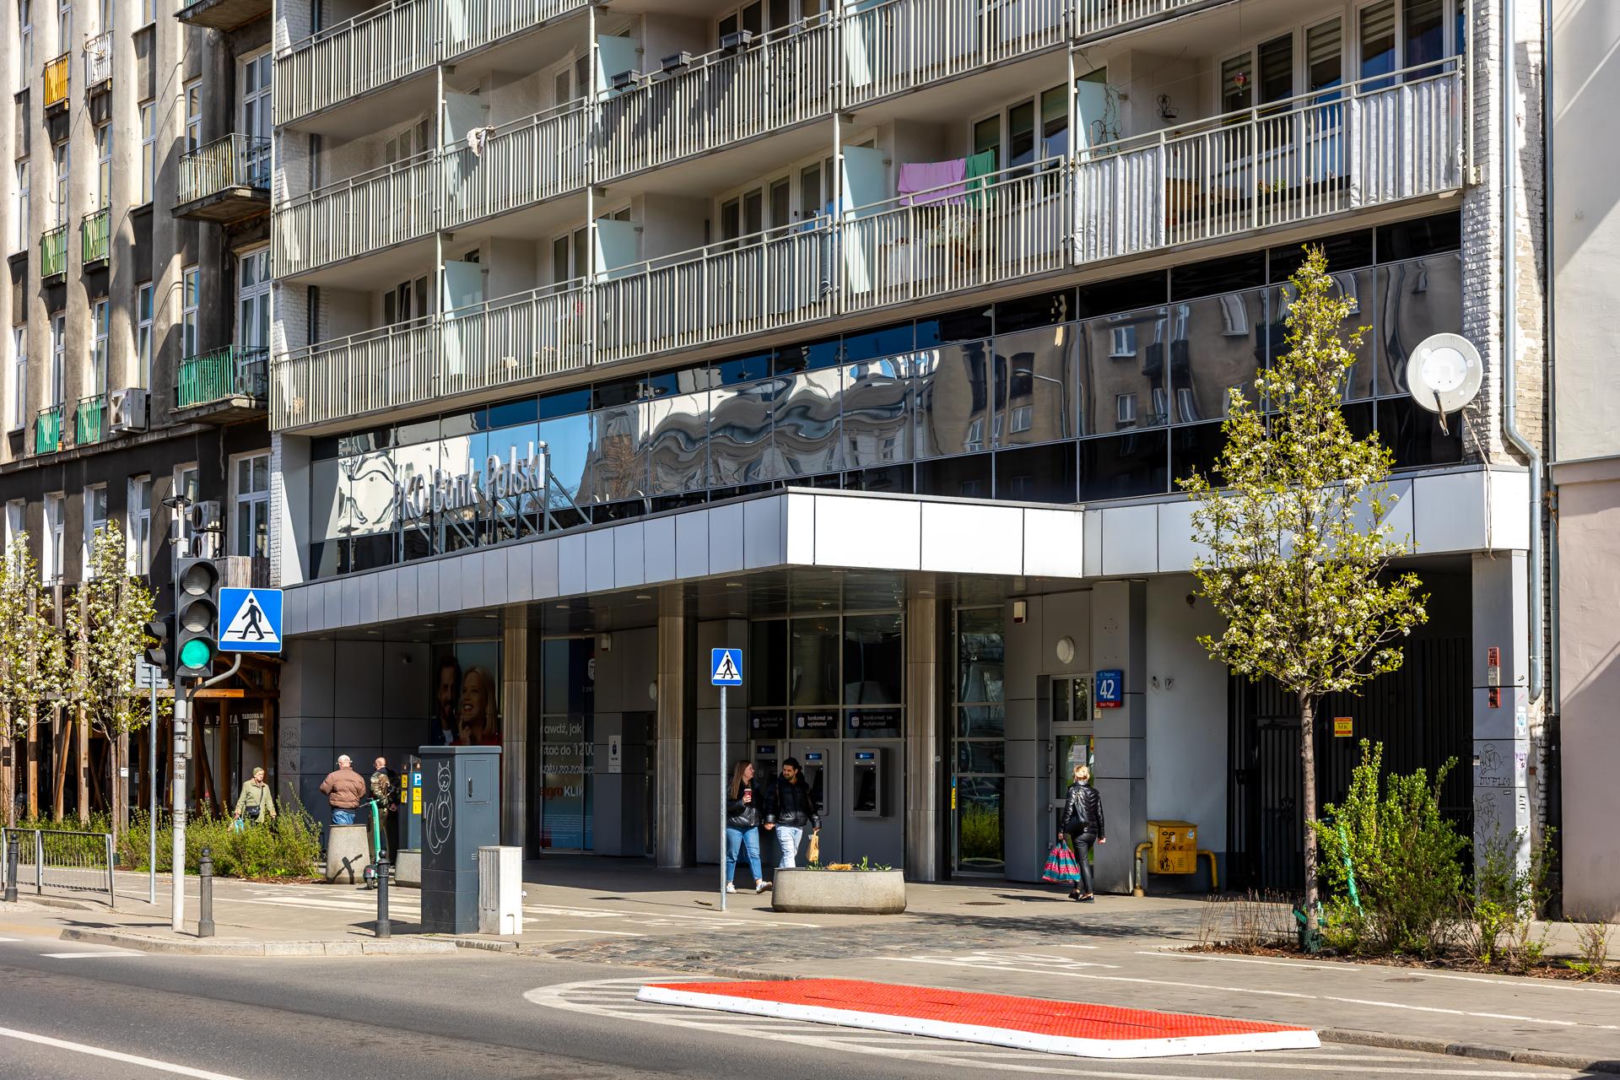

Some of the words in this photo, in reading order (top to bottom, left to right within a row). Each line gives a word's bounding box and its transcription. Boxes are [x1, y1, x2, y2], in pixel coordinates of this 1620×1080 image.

[393, 473, 426, 523] PKO
[433, 458, 480, 513] Bank
[486, 440, 546, 502] Polski
[1100, 679, 1115, 699] 42
[543, 722, 568, 735] awdź,
[560, 743, 572, 756] do
